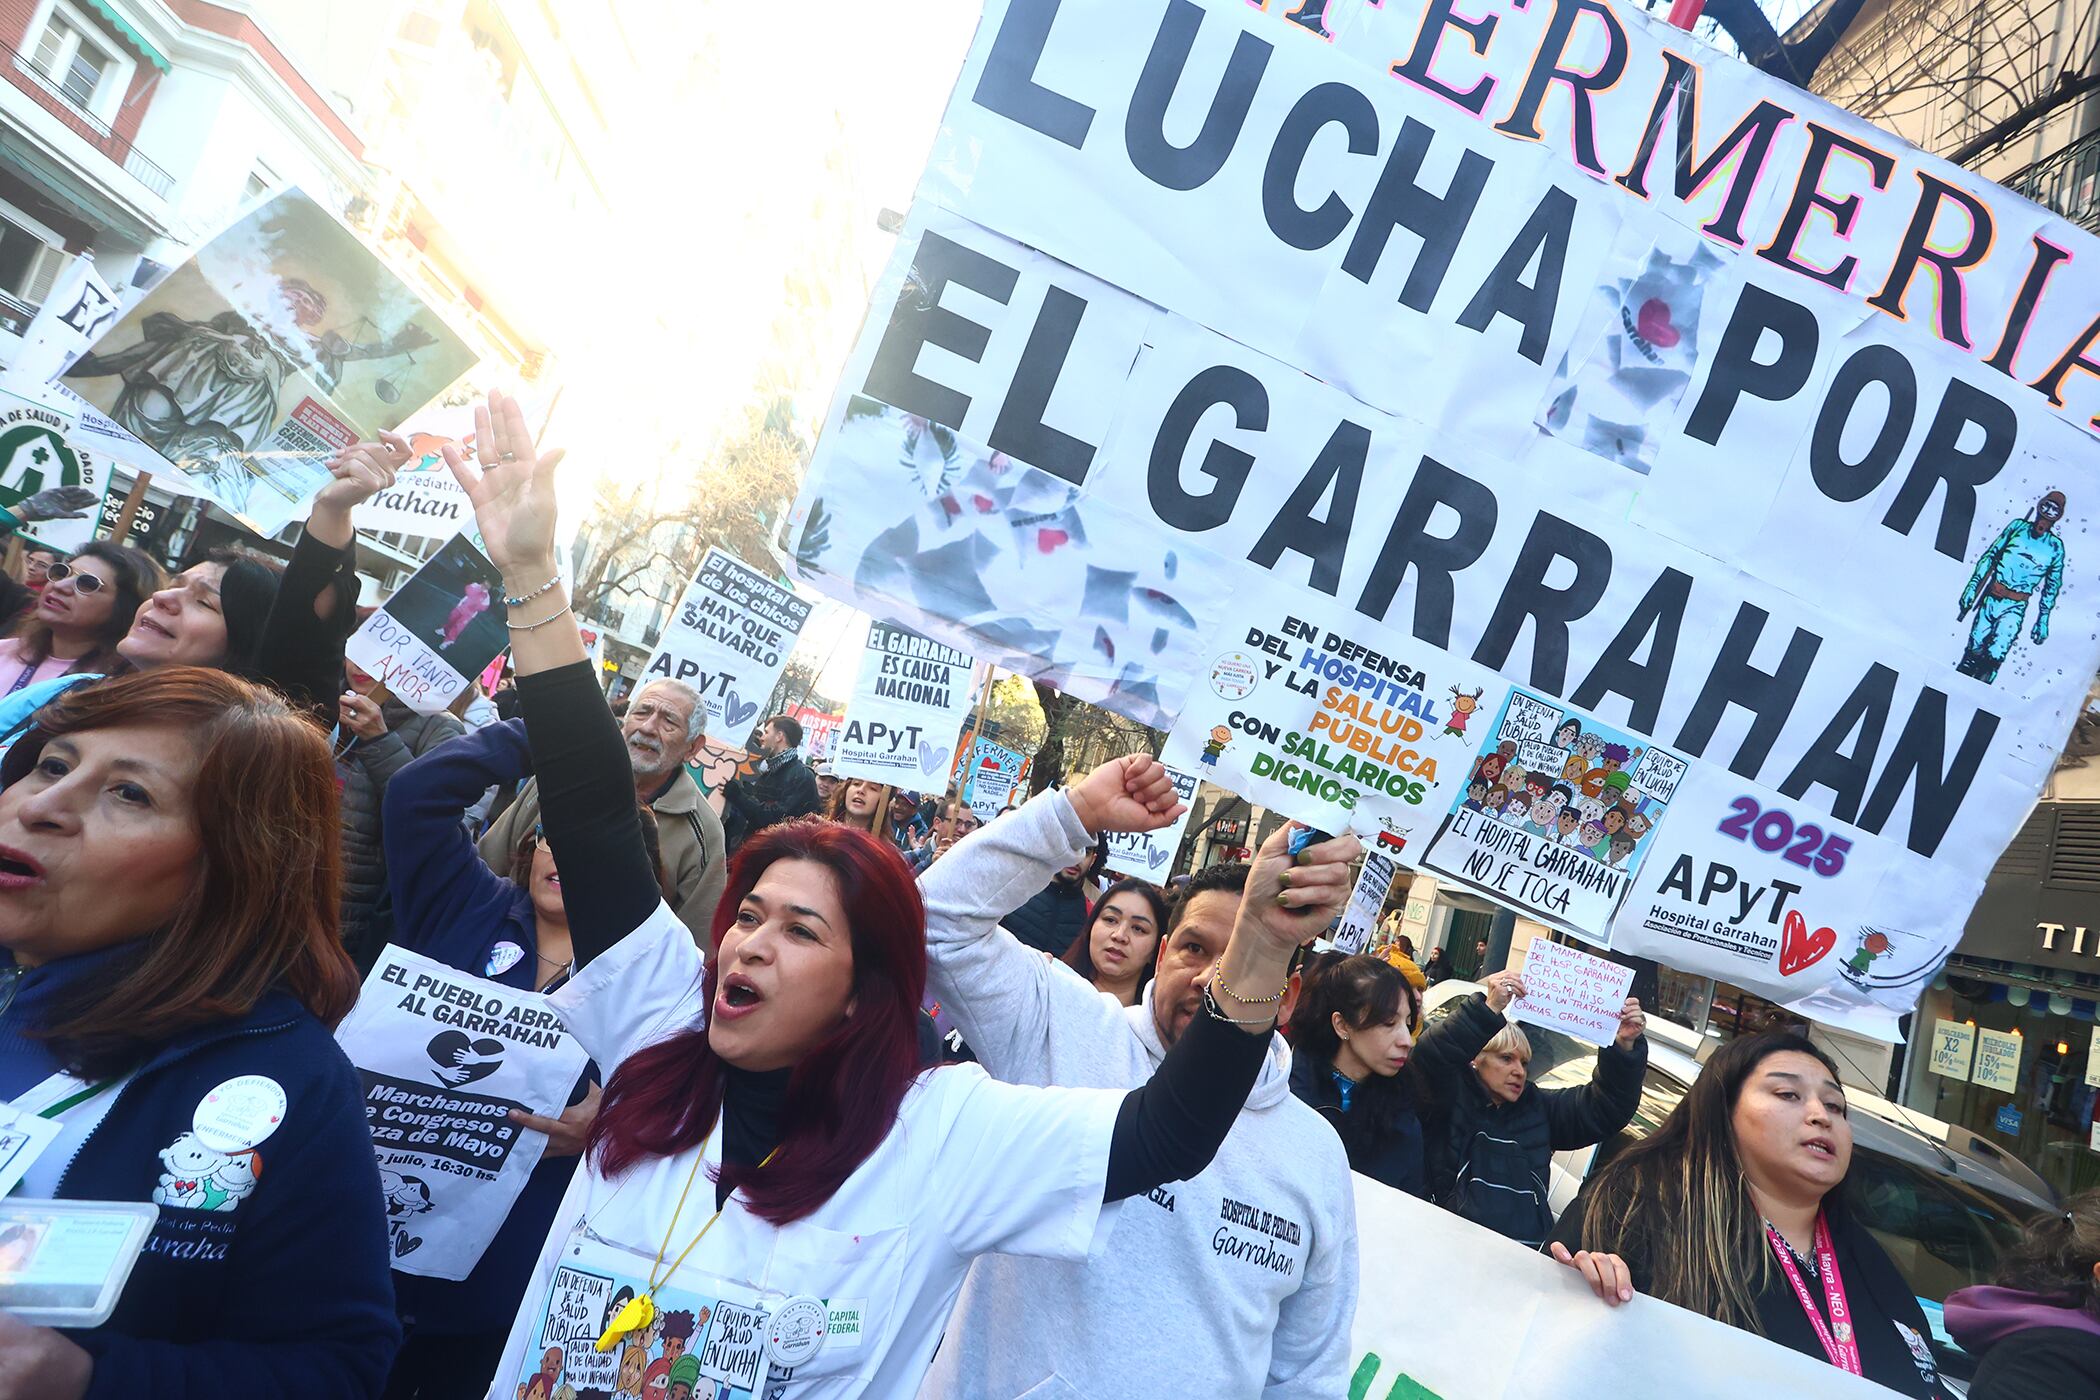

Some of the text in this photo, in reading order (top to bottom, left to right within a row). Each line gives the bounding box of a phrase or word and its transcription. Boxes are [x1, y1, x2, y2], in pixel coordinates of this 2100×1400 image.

[972, 0, 2018, 563] LUCHA POR
[8, 410, 21, 422] DE
[26, 409, 60, 427] SALUD
[63, 424, 70, 433] Y
[104, 493, 155, 521] Sercio
[361, 489, 460, 520] rahan
[862, 229, 2000, 858] EL GARRAHAN
[701, 572, 800, 631] de los chicos
[706, 555, 808, 618] El hospital es
[699, 596, 782, 648] HAY QUE
[368, 613, 458, 695] POR TANTO
[681, 610, 779, 668] SALVARLO
[868, 628, 972, 668] EL GARRAHAN
[1281, 616, 1426, 691] EN DEFENSA
[373, 654, 430, 704] AMOR
[648, 652, 736, 698] APyT
[881, 655, 950, 685] ES CAUSA
[1245, 627, 1439, 725] DEL HOSPITAL
[874, 676, 950, 709] NACIONAL
[1265, 660, 1423, 743] Y LA SALUD
[1512, 694, 1555, 720] EN DEFENSA
[843, 720, 922, 753] APyT
[1513, 715, 1541, 730] SALUD
[842, 748, 877, 760] Hospital
[879, 751, 917, 763] Garrahan
[1227, 711, 1427, 805] CON SALARIOS
[1308, 711, 1440, 788] PÚBLICA,
[1523, 740, 1540, 750] SALUD
[1535, 751, 1559, 763] CALIDAD
[1646, 750, 1673, 768] EQUIPO
[1181, 777, 1194, 788] es
[1250, 752, 1361, 810] DIGNOS
[1633, 768, 1674, 800] EN LUCHA
[1647, 763, 1672, 778] SALUD
[972, 801, 996, 812] APyT
[1103, 831, 1153, 850] APyT
[1716, 794, 1854, 878] 2025
[1452, 810, 1620, 899] EL HOSPITAL GARRAHAN
[1462, 849, 1570, 914] NO SE TOCA
[1657, 853, 1802, 925] APyT
[1644, 921, 1682, 936] Asociación
[1683, 931, 1692, 939] de
[1693, 933, 1737, 951] Profesionales
[1737, 945, 1743, 953] y
[1743, 946, 1772, 960] Técnicos
[1649, 904, 1778, 949] Hospital Garrahan
[2036, 922, 2100, 957] TI
[1529, 963, 1620, 998] GRACIAS A
[1530, 952, 1545, 963] DEL
[1573, 965, 1623, 986] GARRAHAN
[1589, 957, 1598, 966] 10
[1599, 961, 1628, 977] AÑOS
[381, 963, 568, 1032] EL PUEBLO ABRA
[1562, 986, 1576, 997] MI
[397, 993, 561, 1050] AL GARRAHAN
[1934, 1050, 1953, 1066] 10%
[1944, 1036, 1959, 1053] X2
[1979, 1053, 2000, 1069] 15%
[1977, 1066, 1998, 1082] 10%
[367, 1084, 509, 1117] Marchamos
[366, 1106, 513, 1140] e Congreso a
[2000, 1115, 2018, 1127] VISA
[370, 1125, 504, 1159] aza de Mayo
[376, 1153, 497, 1181] e julio, 16:30 hs.
[1147, 1186, 1175, 1212] GIA
[1221, 1197, 1259, 1230] HOSPITAL
[1260, 1211, 1272, 1233] DE
[180, 1220, 196, 1230] de
[1212, 1226, 1295, 1276] Garrahan
[558, 1271, 603, 1298] EN DEFENSA
[1772, 1238, 1815, 1311] NEO Mayra
[1821, 1253, 1844, 1317] Mayra NEO
[558, 1302, 588, 1320] SALUD
[563, 1291, 584, 1305] DE LA
[716, 1304, 767, 1330] EQUIPO DE
[827, 1322, 860, 1334] FEDERAL
[829, 1311, 859, 1322] CAPITAL
[569, 1341, 589, 1355] SALUD
[719, 1325, 752, 1345] SALUD
[568, 1356, 612, 1368] Y DE CALIDAD
[703, 1340, 756, 1385] EN LUCHA
